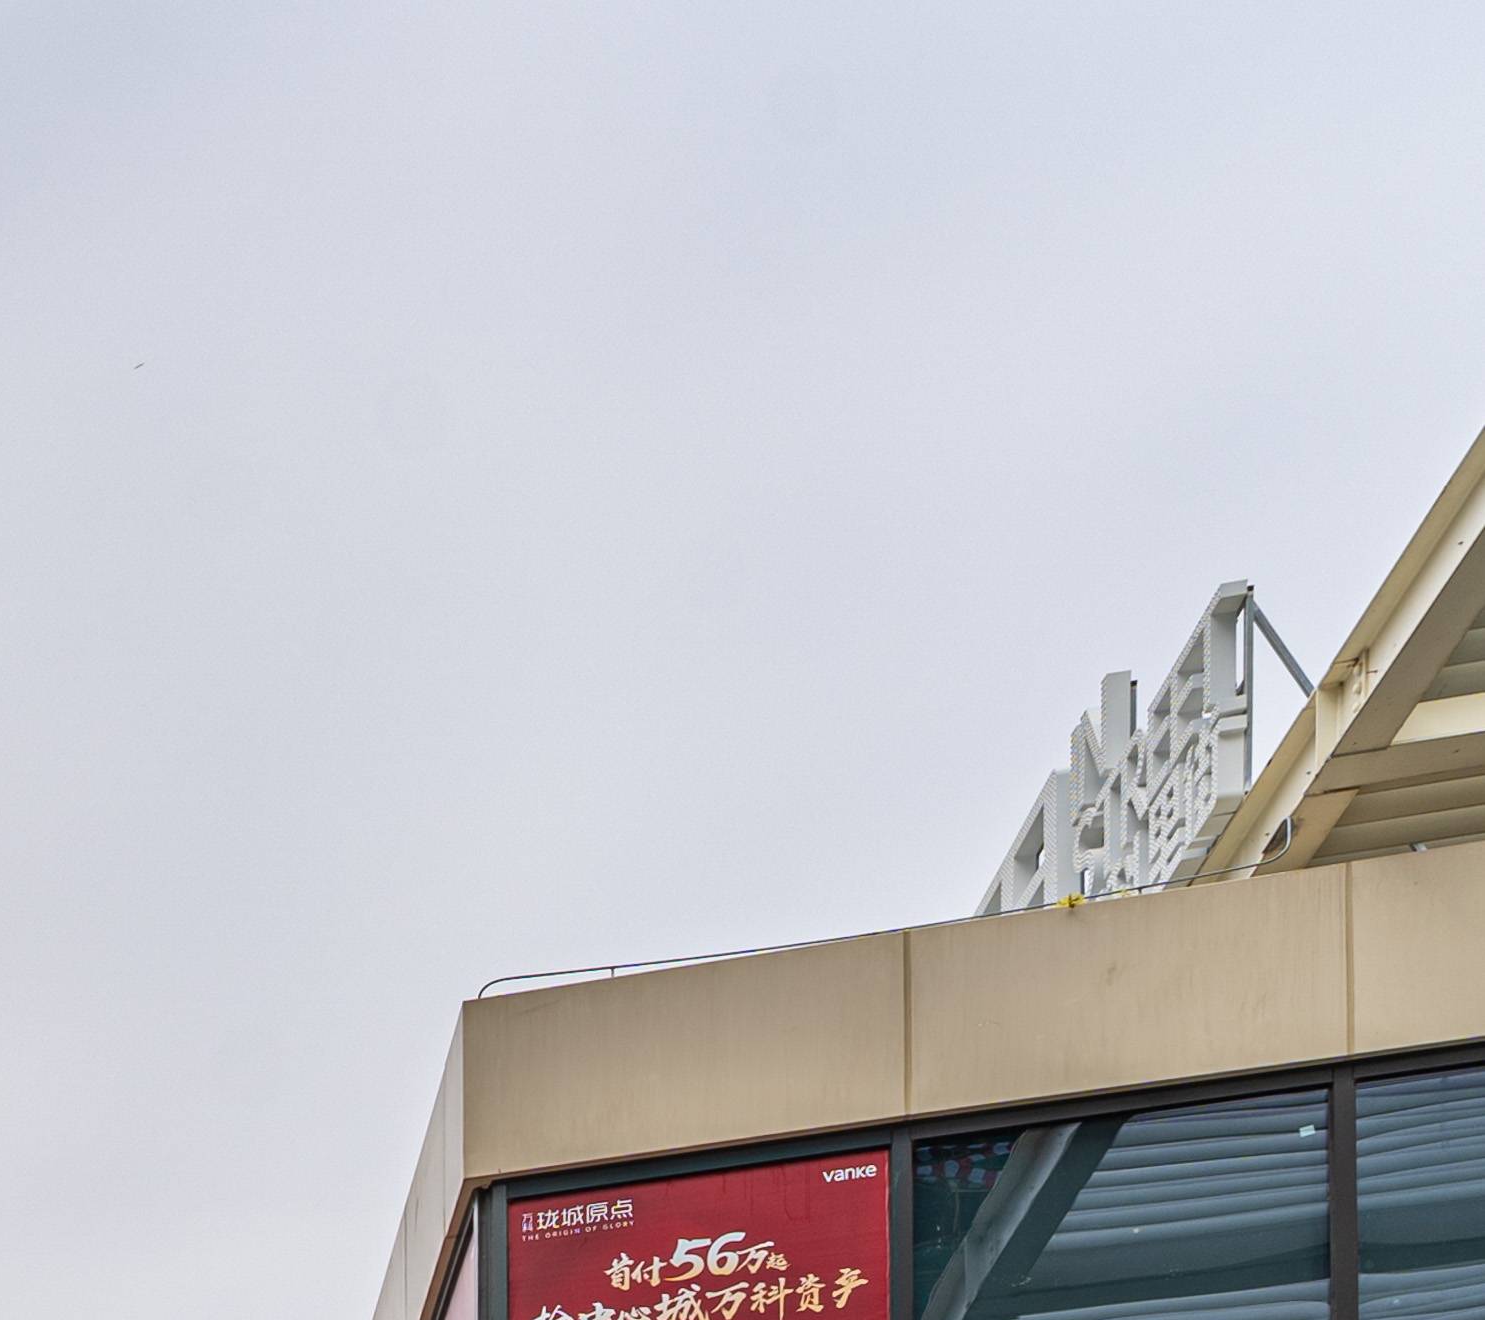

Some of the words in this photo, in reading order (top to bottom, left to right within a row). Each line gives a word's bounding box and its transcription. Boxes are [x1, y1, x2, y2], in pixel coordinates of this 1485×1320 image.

[822, 1164, 878, 1183] vanke
[537, 1199, 634, 1231] 珑城原点
[604, 1231, 793, 1292] 首付56万起
